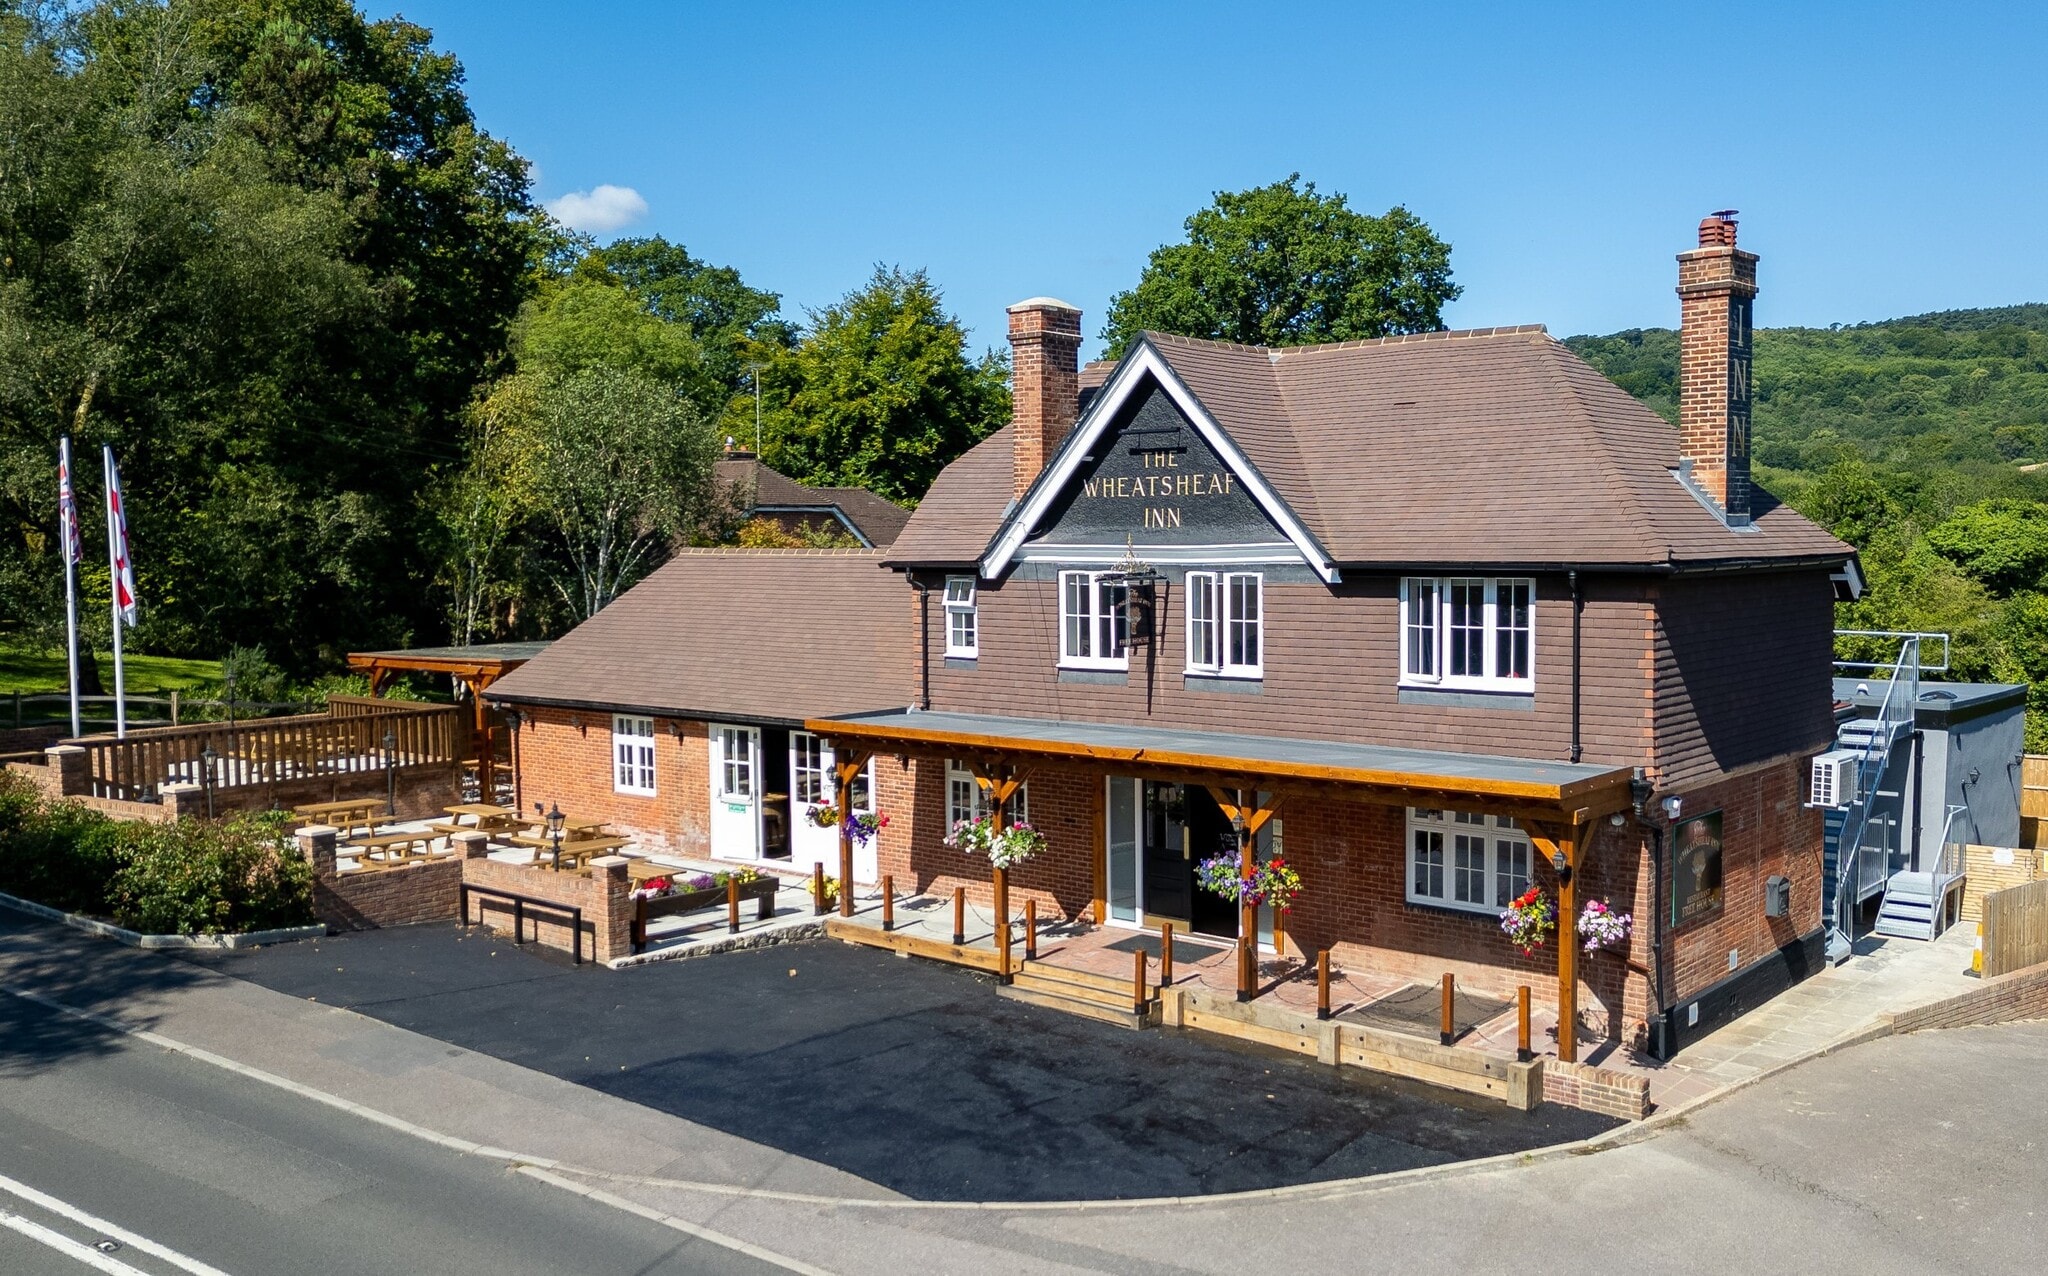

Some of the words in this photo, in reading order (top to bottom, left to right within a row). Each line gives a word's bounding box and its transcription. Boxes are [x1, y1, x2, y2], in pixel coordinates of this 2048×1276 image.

[1732, 304, 1747, 458] INN
[1142, 450, 1178, 468] THE
[1083, 473, 1236, 498] WHEATSHEAF
[1144, 507, 1181, 528] INN
